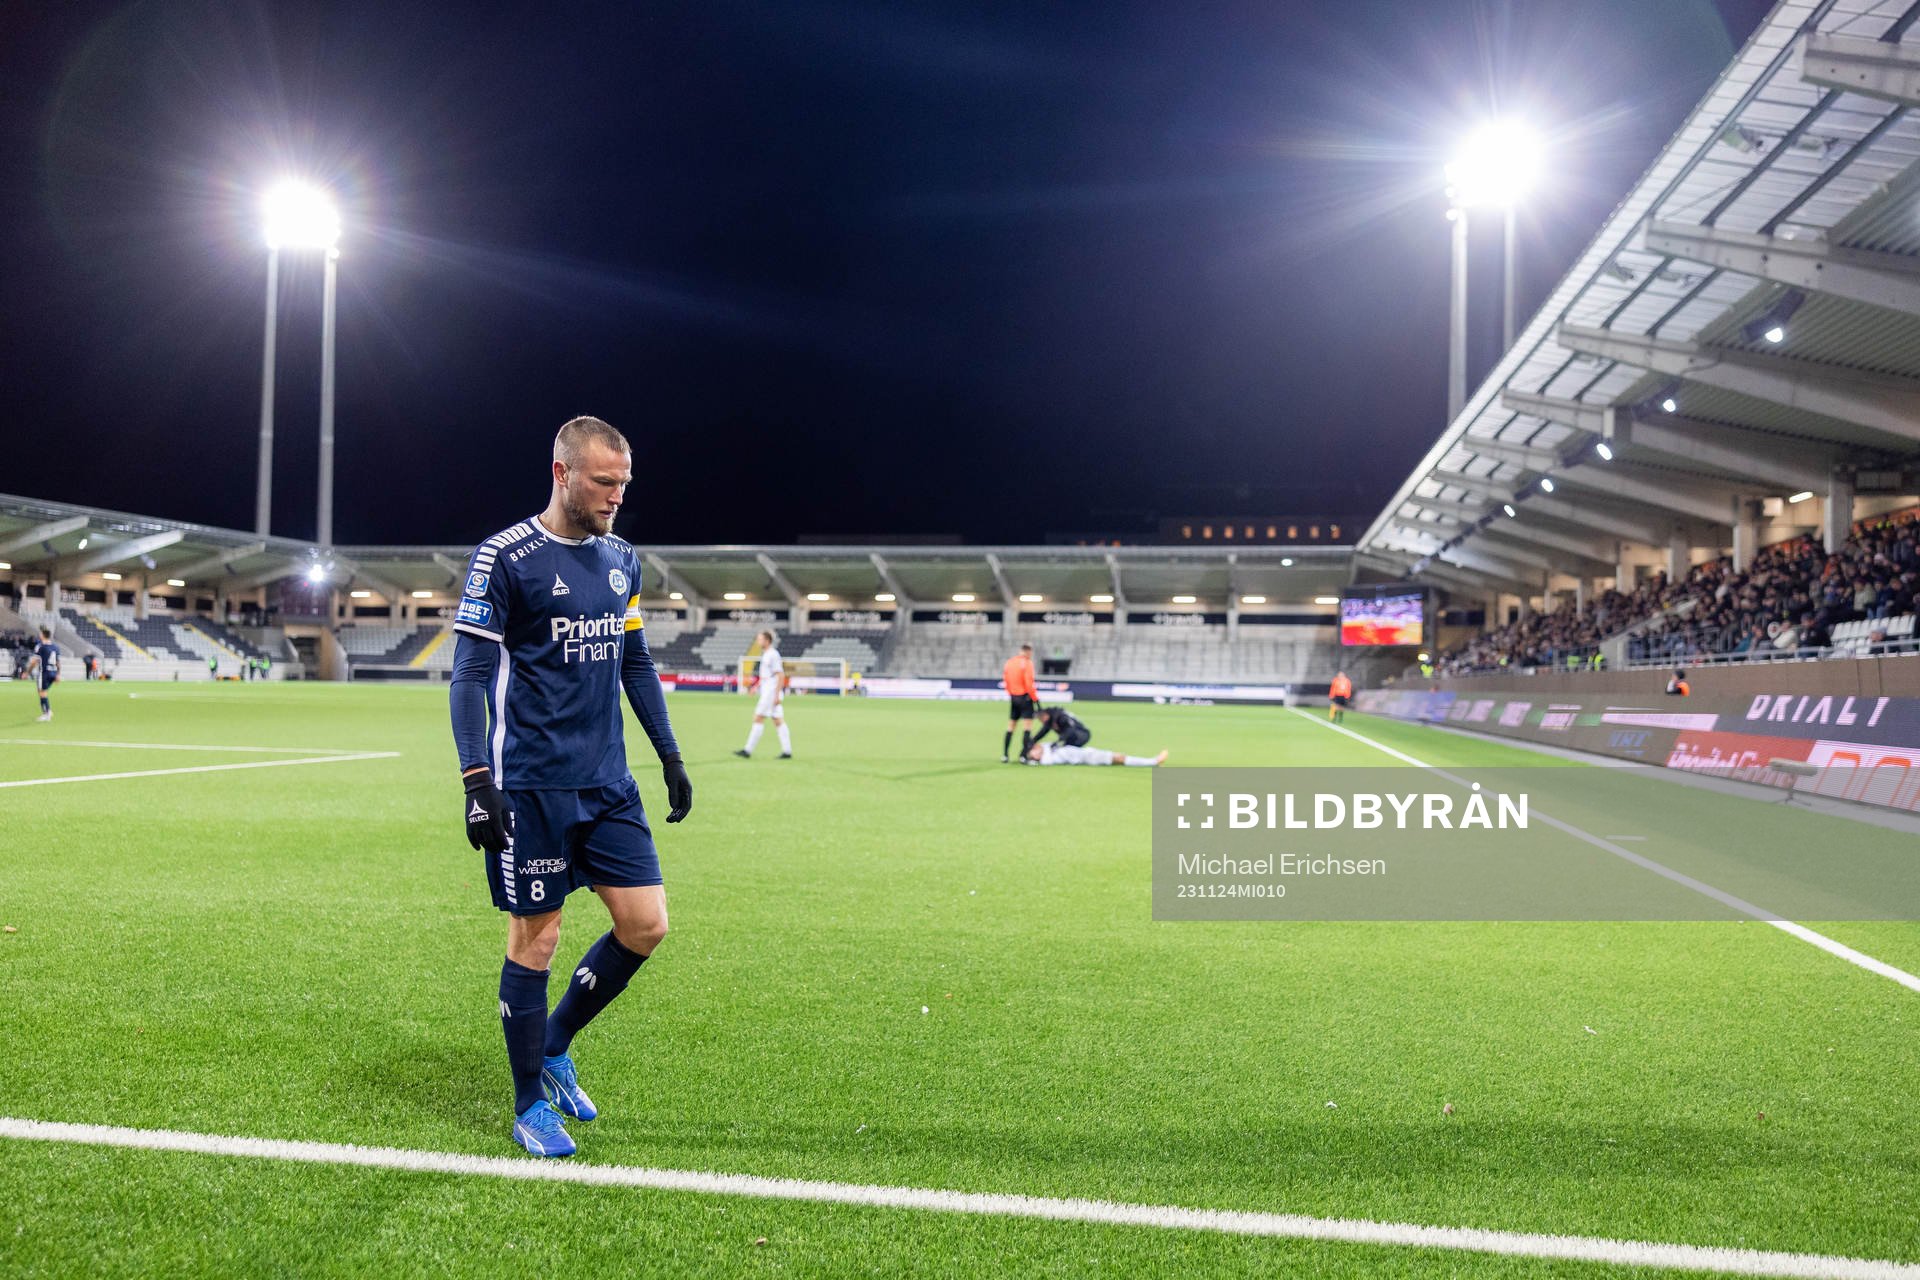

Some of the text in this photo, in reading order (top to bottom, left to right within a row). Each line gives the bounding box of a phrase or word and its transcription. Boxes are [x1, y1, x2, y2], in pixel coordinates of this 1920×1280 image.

[509, 535, 549, 562] BRIXLY
[552, 588, 570, 596] SELECT
[468, 814, 489, 823] SELECT
[527, 857, 564, 867] NORDIC
[530, 879, 545, 902] 8
